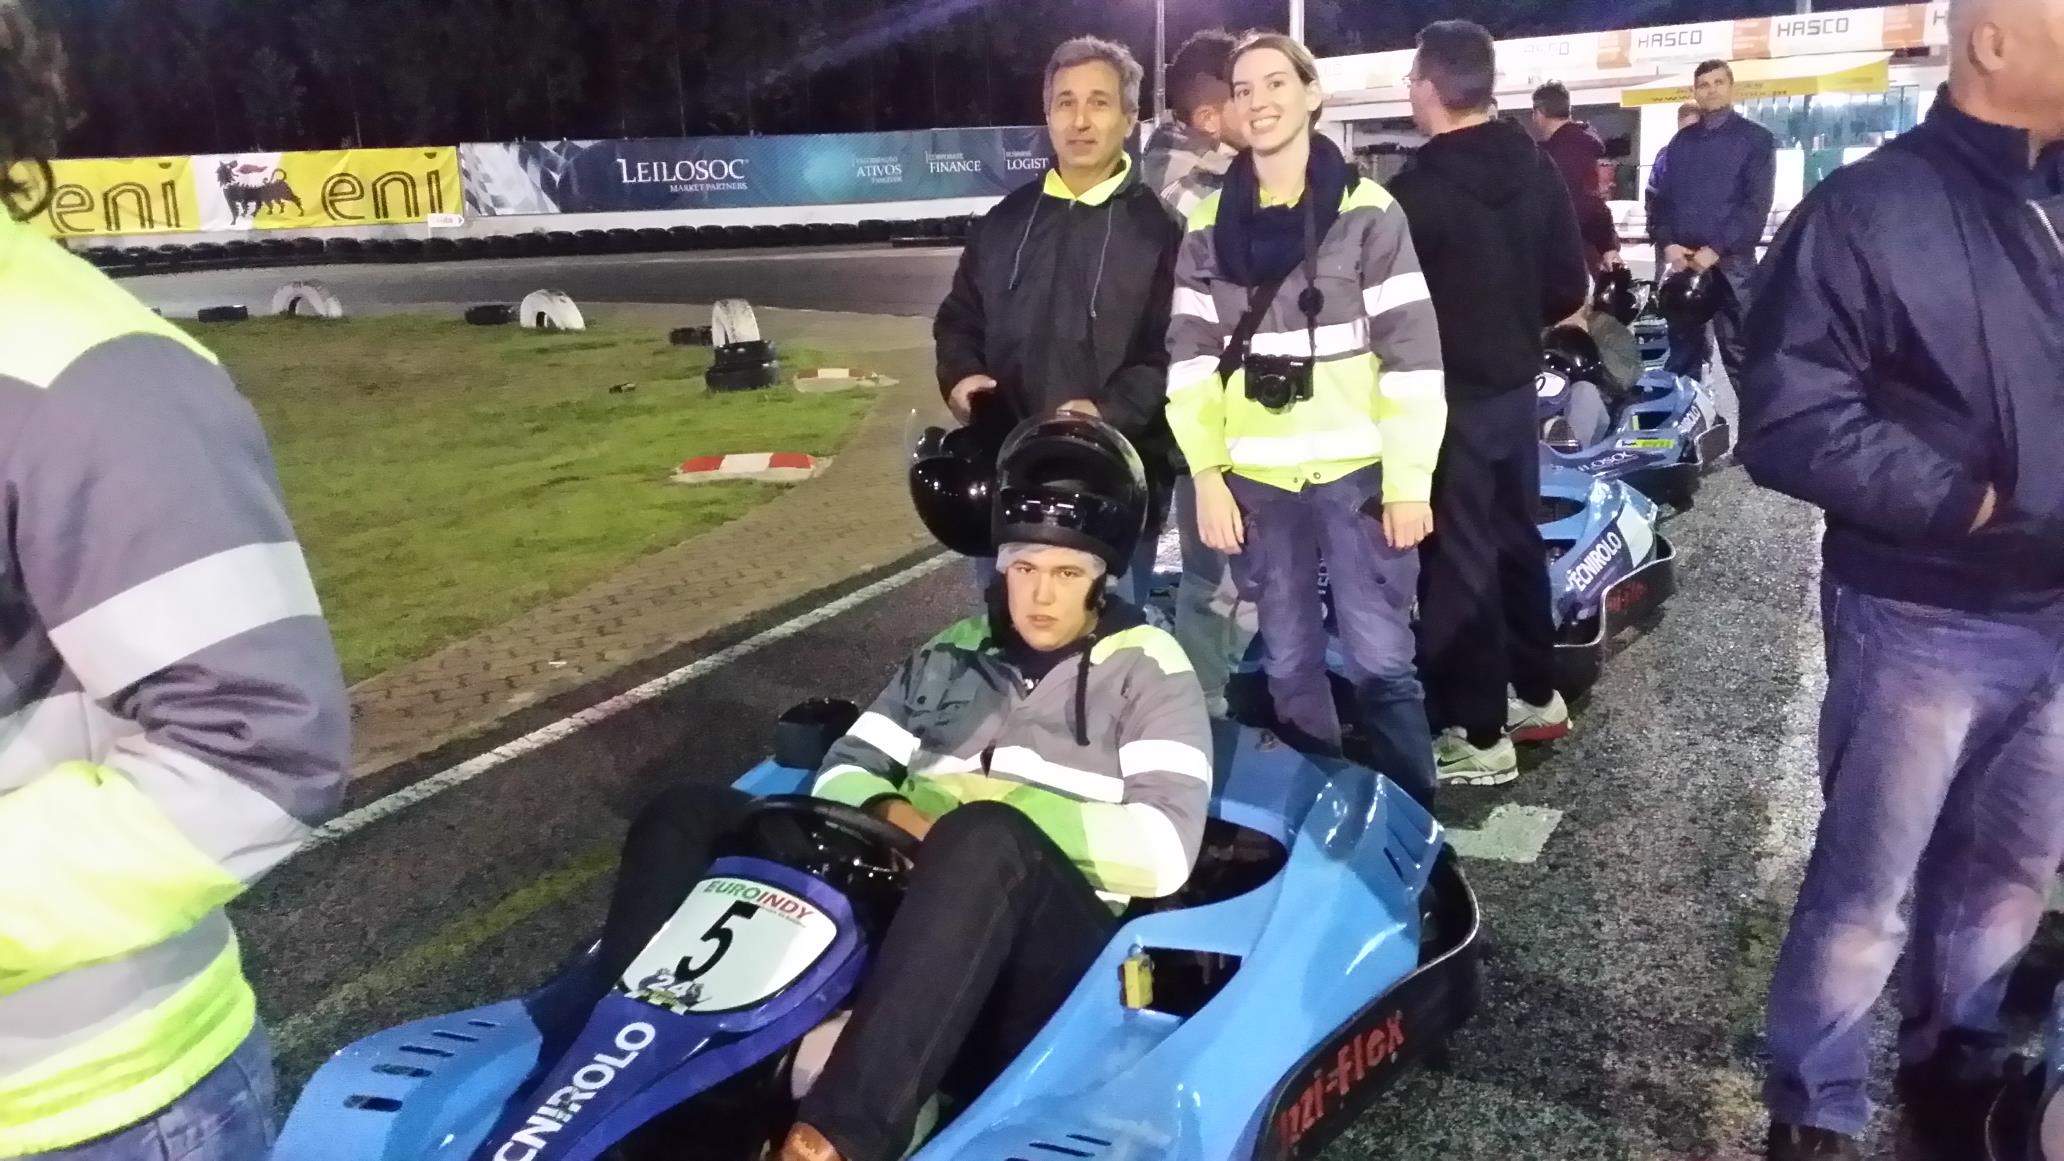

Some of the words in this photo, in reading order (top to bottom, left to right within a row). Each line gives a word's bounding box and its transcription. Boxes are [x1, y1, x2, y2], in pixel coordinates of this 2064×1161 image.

[1776, 17, 1850, 38] HASCO
[1637, 29, 1703, 49] HASCO
[616, 157, 747, 184] LEILOSOC
[856, 163, 903, 177] ATIVOS
[929, 159, 982, 174] FINANCE
[1006, 157, 1049, 171] LOGIST
[320, 151, 444, 221] eni
[669, 183, 704, 193] MARKET
[705, 181, 748, 192] PARTNERS
[47, 161, 182, 234] eni
[703, 880, 815, 919] EUROINDY
[675, 899, 762, 982] 5
